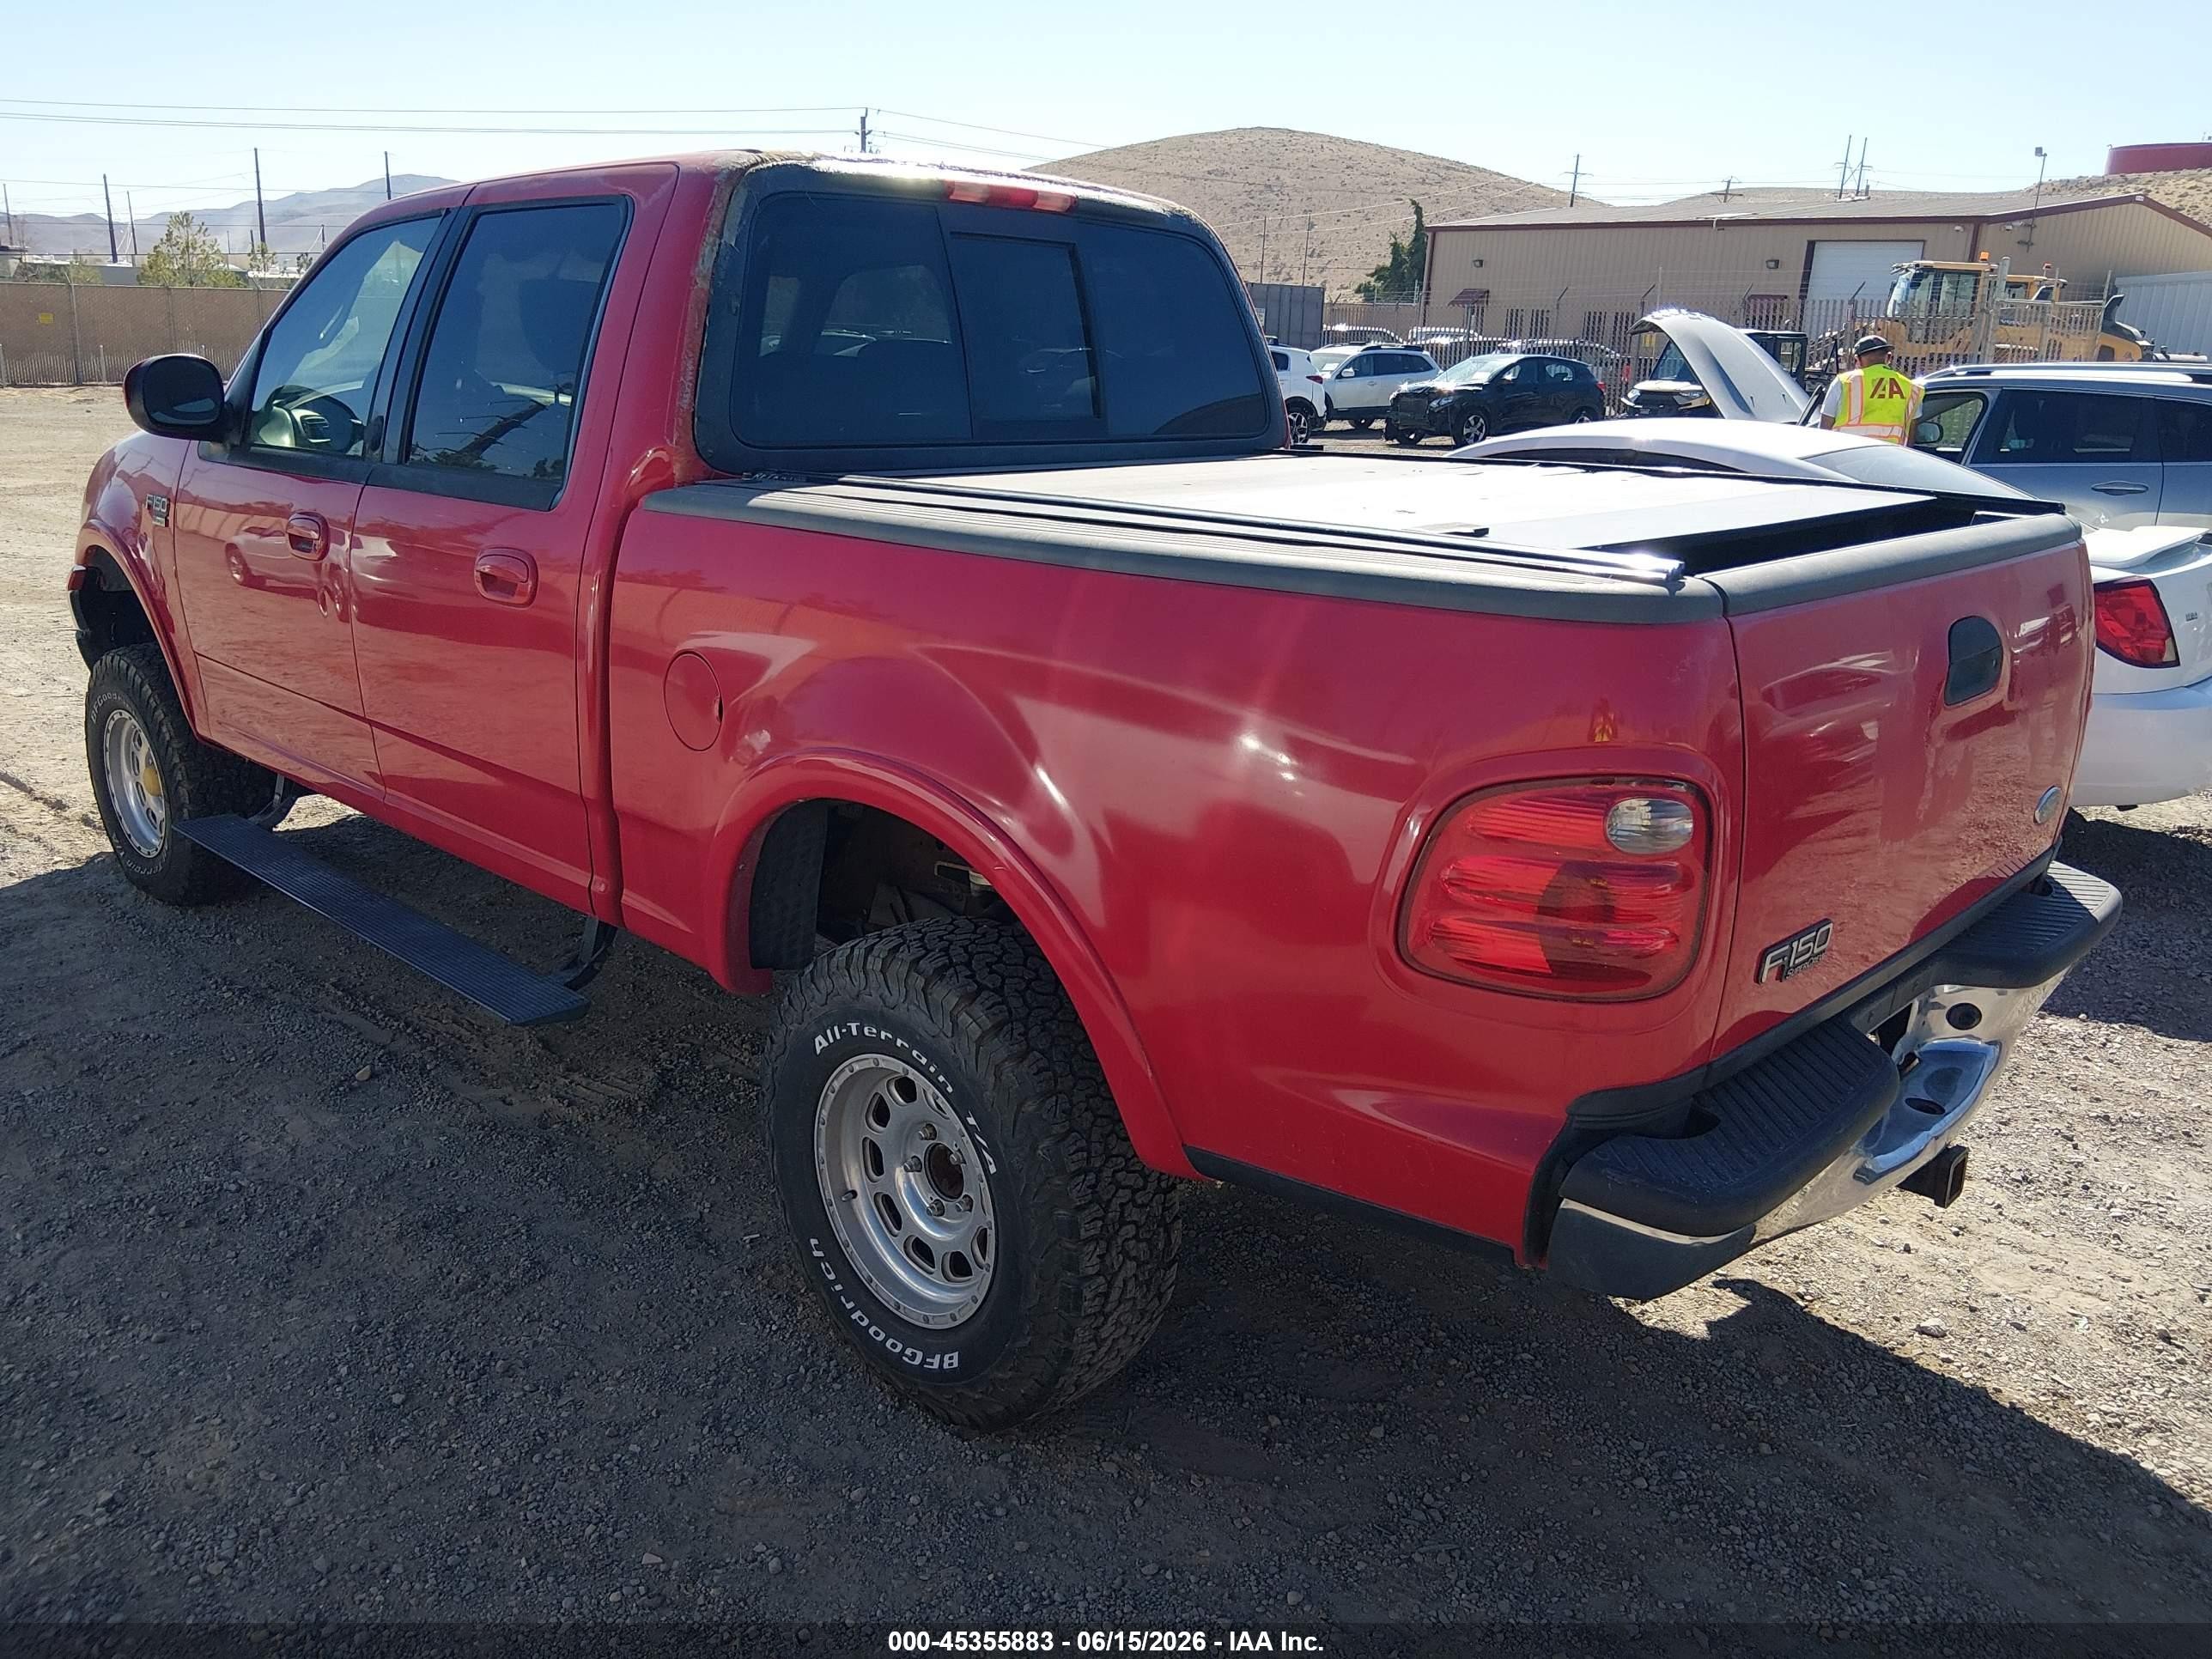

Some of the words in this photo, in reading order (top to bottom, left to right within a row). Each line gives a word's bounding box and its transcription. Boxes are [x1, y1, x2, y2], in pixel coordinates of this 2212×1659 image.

[814, 1022, 954, 1093] All-Terrain
[966, 1109, 997, 1175] T/A
[810, 1238, 959, 1369] BFGoodrich
